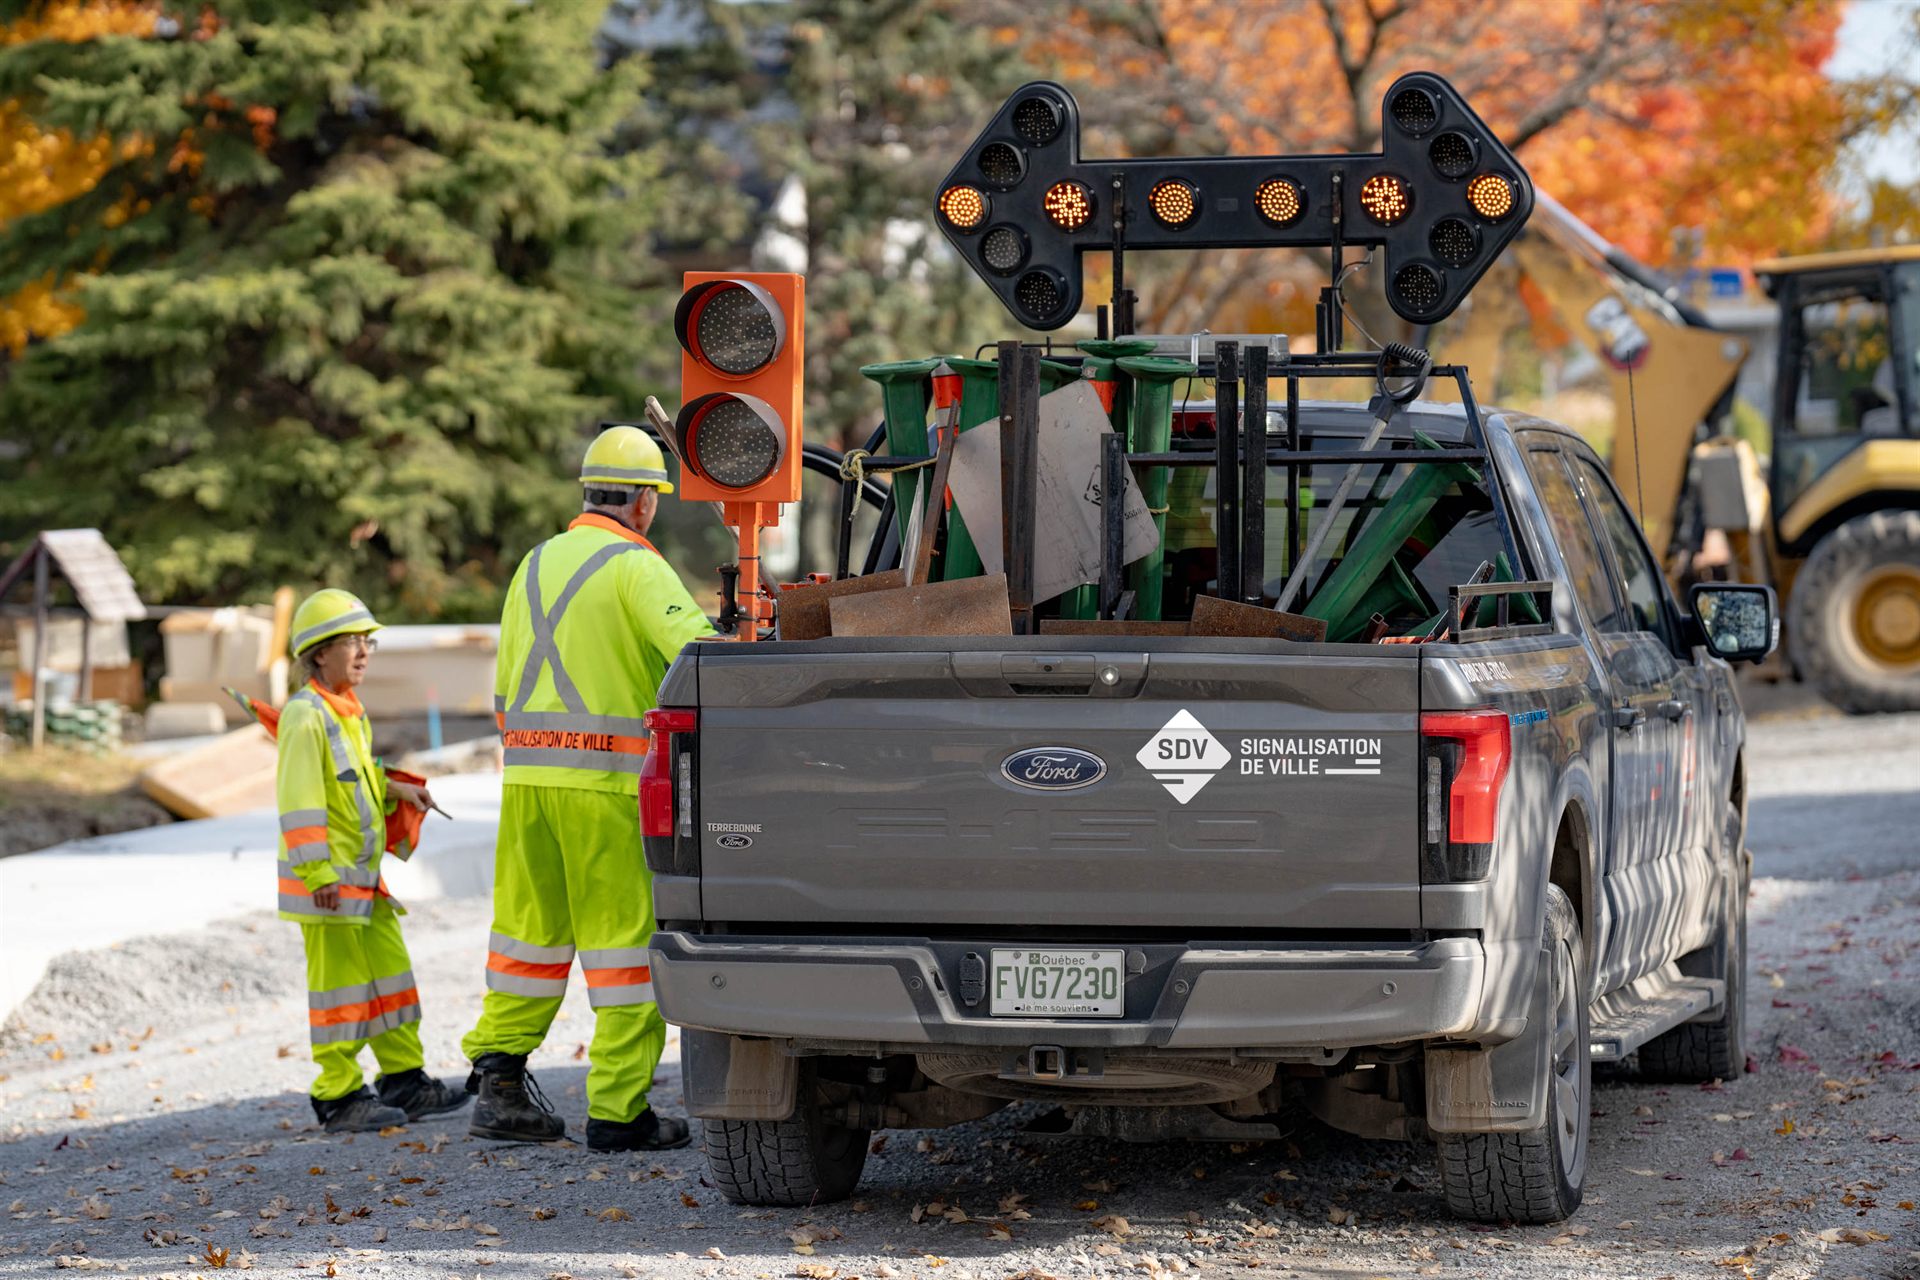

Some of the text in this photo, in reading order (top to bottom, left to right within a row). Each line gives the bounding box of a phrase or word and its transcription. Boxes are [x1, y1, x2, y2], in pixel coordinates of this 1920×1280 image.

[565, 733, 579, 749] DE
[583, 734, 613, 752] VILLE
[1157, 738, 1208, 760] SDV
[1240, 738, 1381, 755] SIGNALISATION
[1025, 755, 1080, 781] Ford
[1240, 759, 1319, 775] DE VILLE
[706, 822, 762, 833] TERREBONNE
[724, 836, 745, 847] Ford
[1042, 955, 1085, 966] Québec
[996, 966, 1118, 1000] FVG7230
[1020, 1004, 1031, 1012] Je
[1050, 1004, 1092, 1013] souviens
